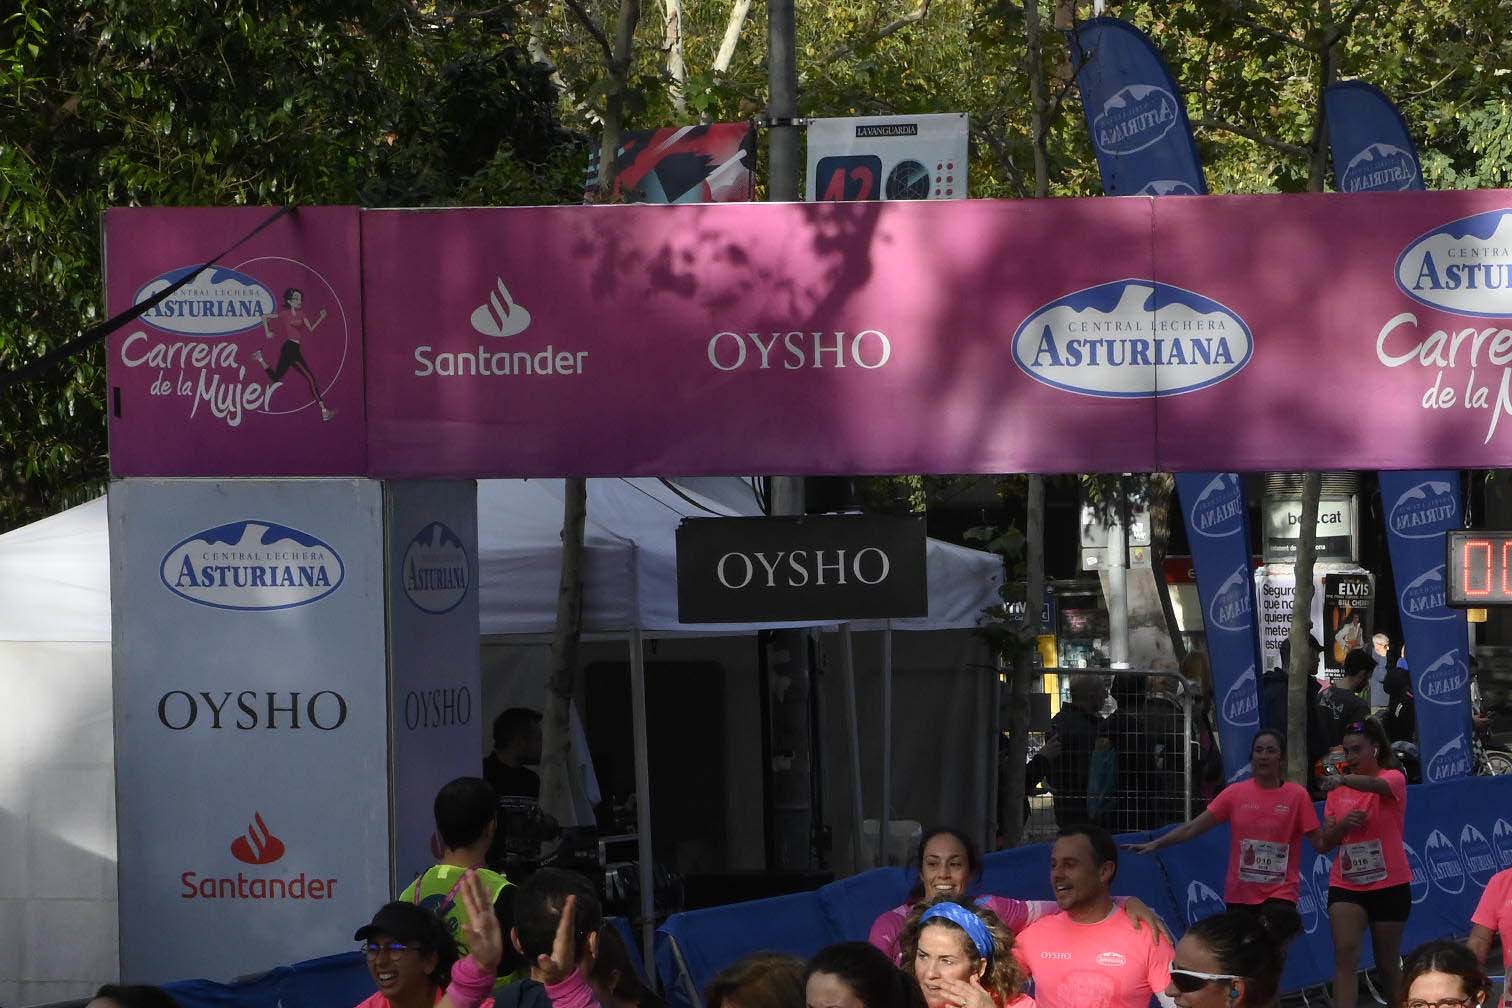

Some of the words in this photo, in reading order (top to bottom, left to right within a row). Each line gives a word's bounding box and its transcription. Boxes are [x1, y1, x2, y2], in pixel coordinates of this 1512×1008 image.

[173, 288, 210, 296] ENTRAL
[1068, 321, 1143, 332] CENTRAL
[1151, 319, 1226, 331] LECHERA
[121, 331, 238, 368] Carrera
[413, 344, 589, 377] Santander
[708, 329, 892, 371] OYSHO
[1030, 324, 1235, 367] ASTURIANA
[151, 370, 172, 396] de
[177, 370, 192, 396] la
[191, 366, 283, 427] Mujer
[1422, 371, 1456, 409] de
[1464, 371, 1489, 409] la
[174, 553, 332, 588] ASTURIANA
[203, 551, 261, 561] CENTRAL
[267, 551, 325, 561] LECHERA
[716, 547, 891, 590] OYSHO
[407, 558, 466, 592] ASTURIANA
[1338, 583, 1369, 596] ELVIS
[1263, 600, 1280, 612] que
[157, 690, 348, 731] OYSHO
[405, 686, 472, 731] OYSHO
[181, 871, 338, 900] Santander
[1041, 951, 1073, 960] OYSHO
